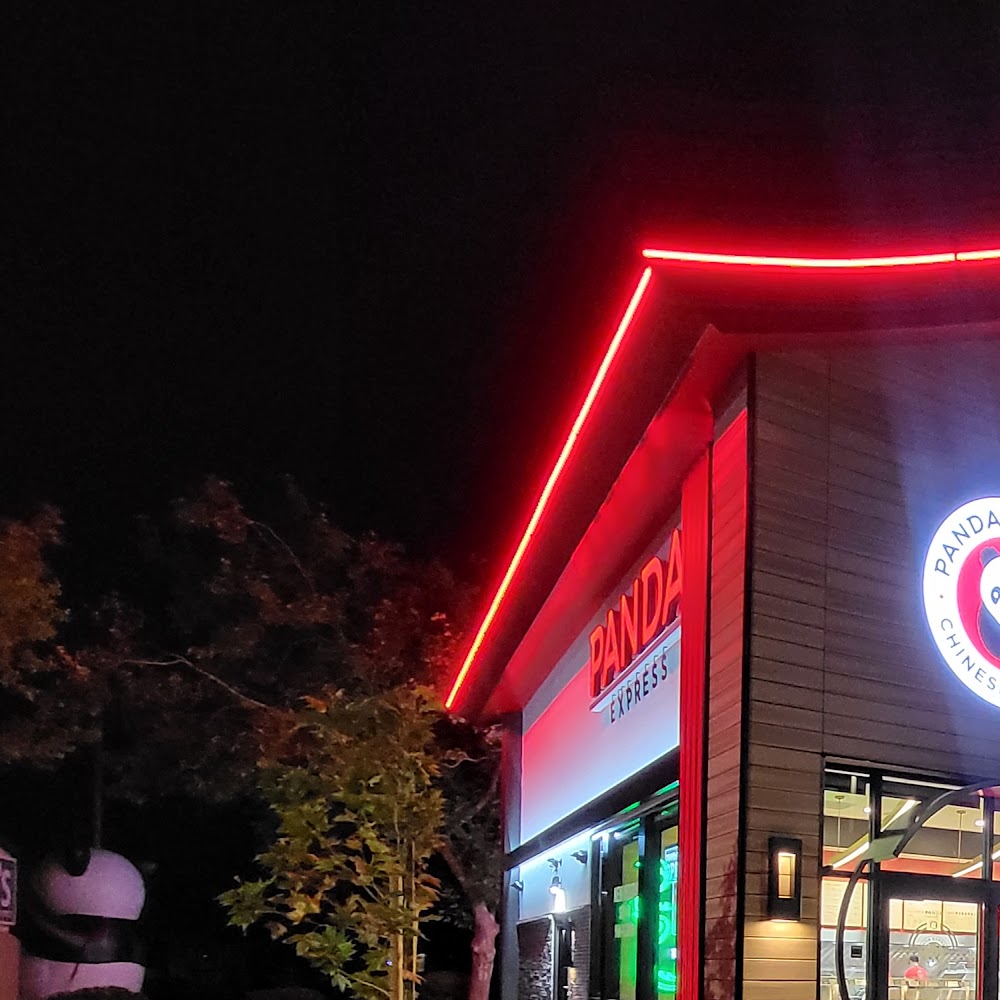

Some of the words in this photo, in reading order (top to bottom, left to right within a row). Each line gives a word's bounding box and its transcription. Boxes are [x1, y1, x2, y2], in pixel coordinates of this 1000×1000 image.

[935, 510, 1000, 577] PANDA
[590, 529, 682, 698] PANDA
[610, 649, 668, 724] EXPRESS
